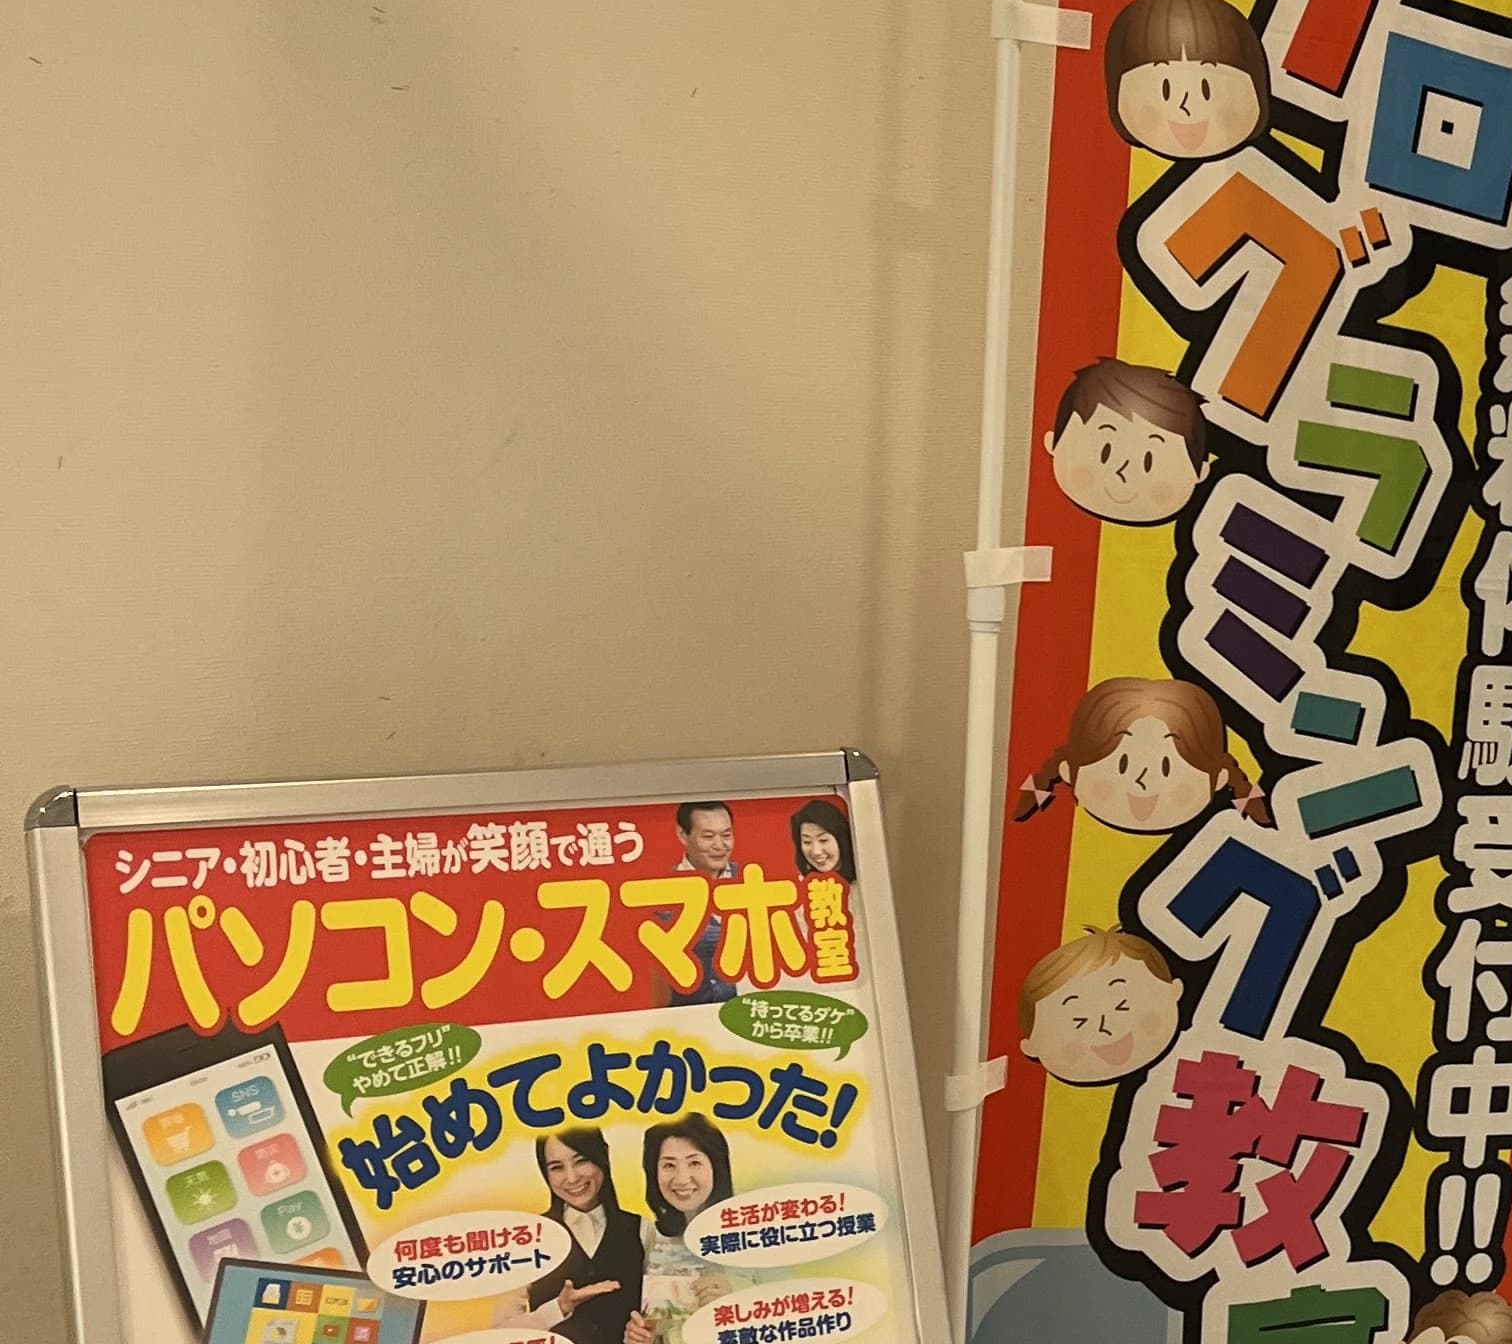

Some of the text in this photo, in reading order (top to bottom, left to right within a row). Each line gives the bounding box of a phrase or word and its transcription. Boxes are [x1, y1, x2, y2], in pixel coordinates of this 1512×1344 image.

[115, 821, 643, 894] シニア・初心者・主婦が笑顔で通う
[111, 863, 854, 1036] パソコン・スマホ 教室
[338, 1040, 858, 1209] 始めてよかった!
[720, 1193, 846, 1228] 生活が変わる!
[394, 1223, 543, 1262] 何度も聞ける!
[700, 1212, 877, 1256] 実際に役に立つ授業
[392, 1249, 552, 1289] 安心のサポート
[714, 1287, 854, 1327] 楽しみが増える!
